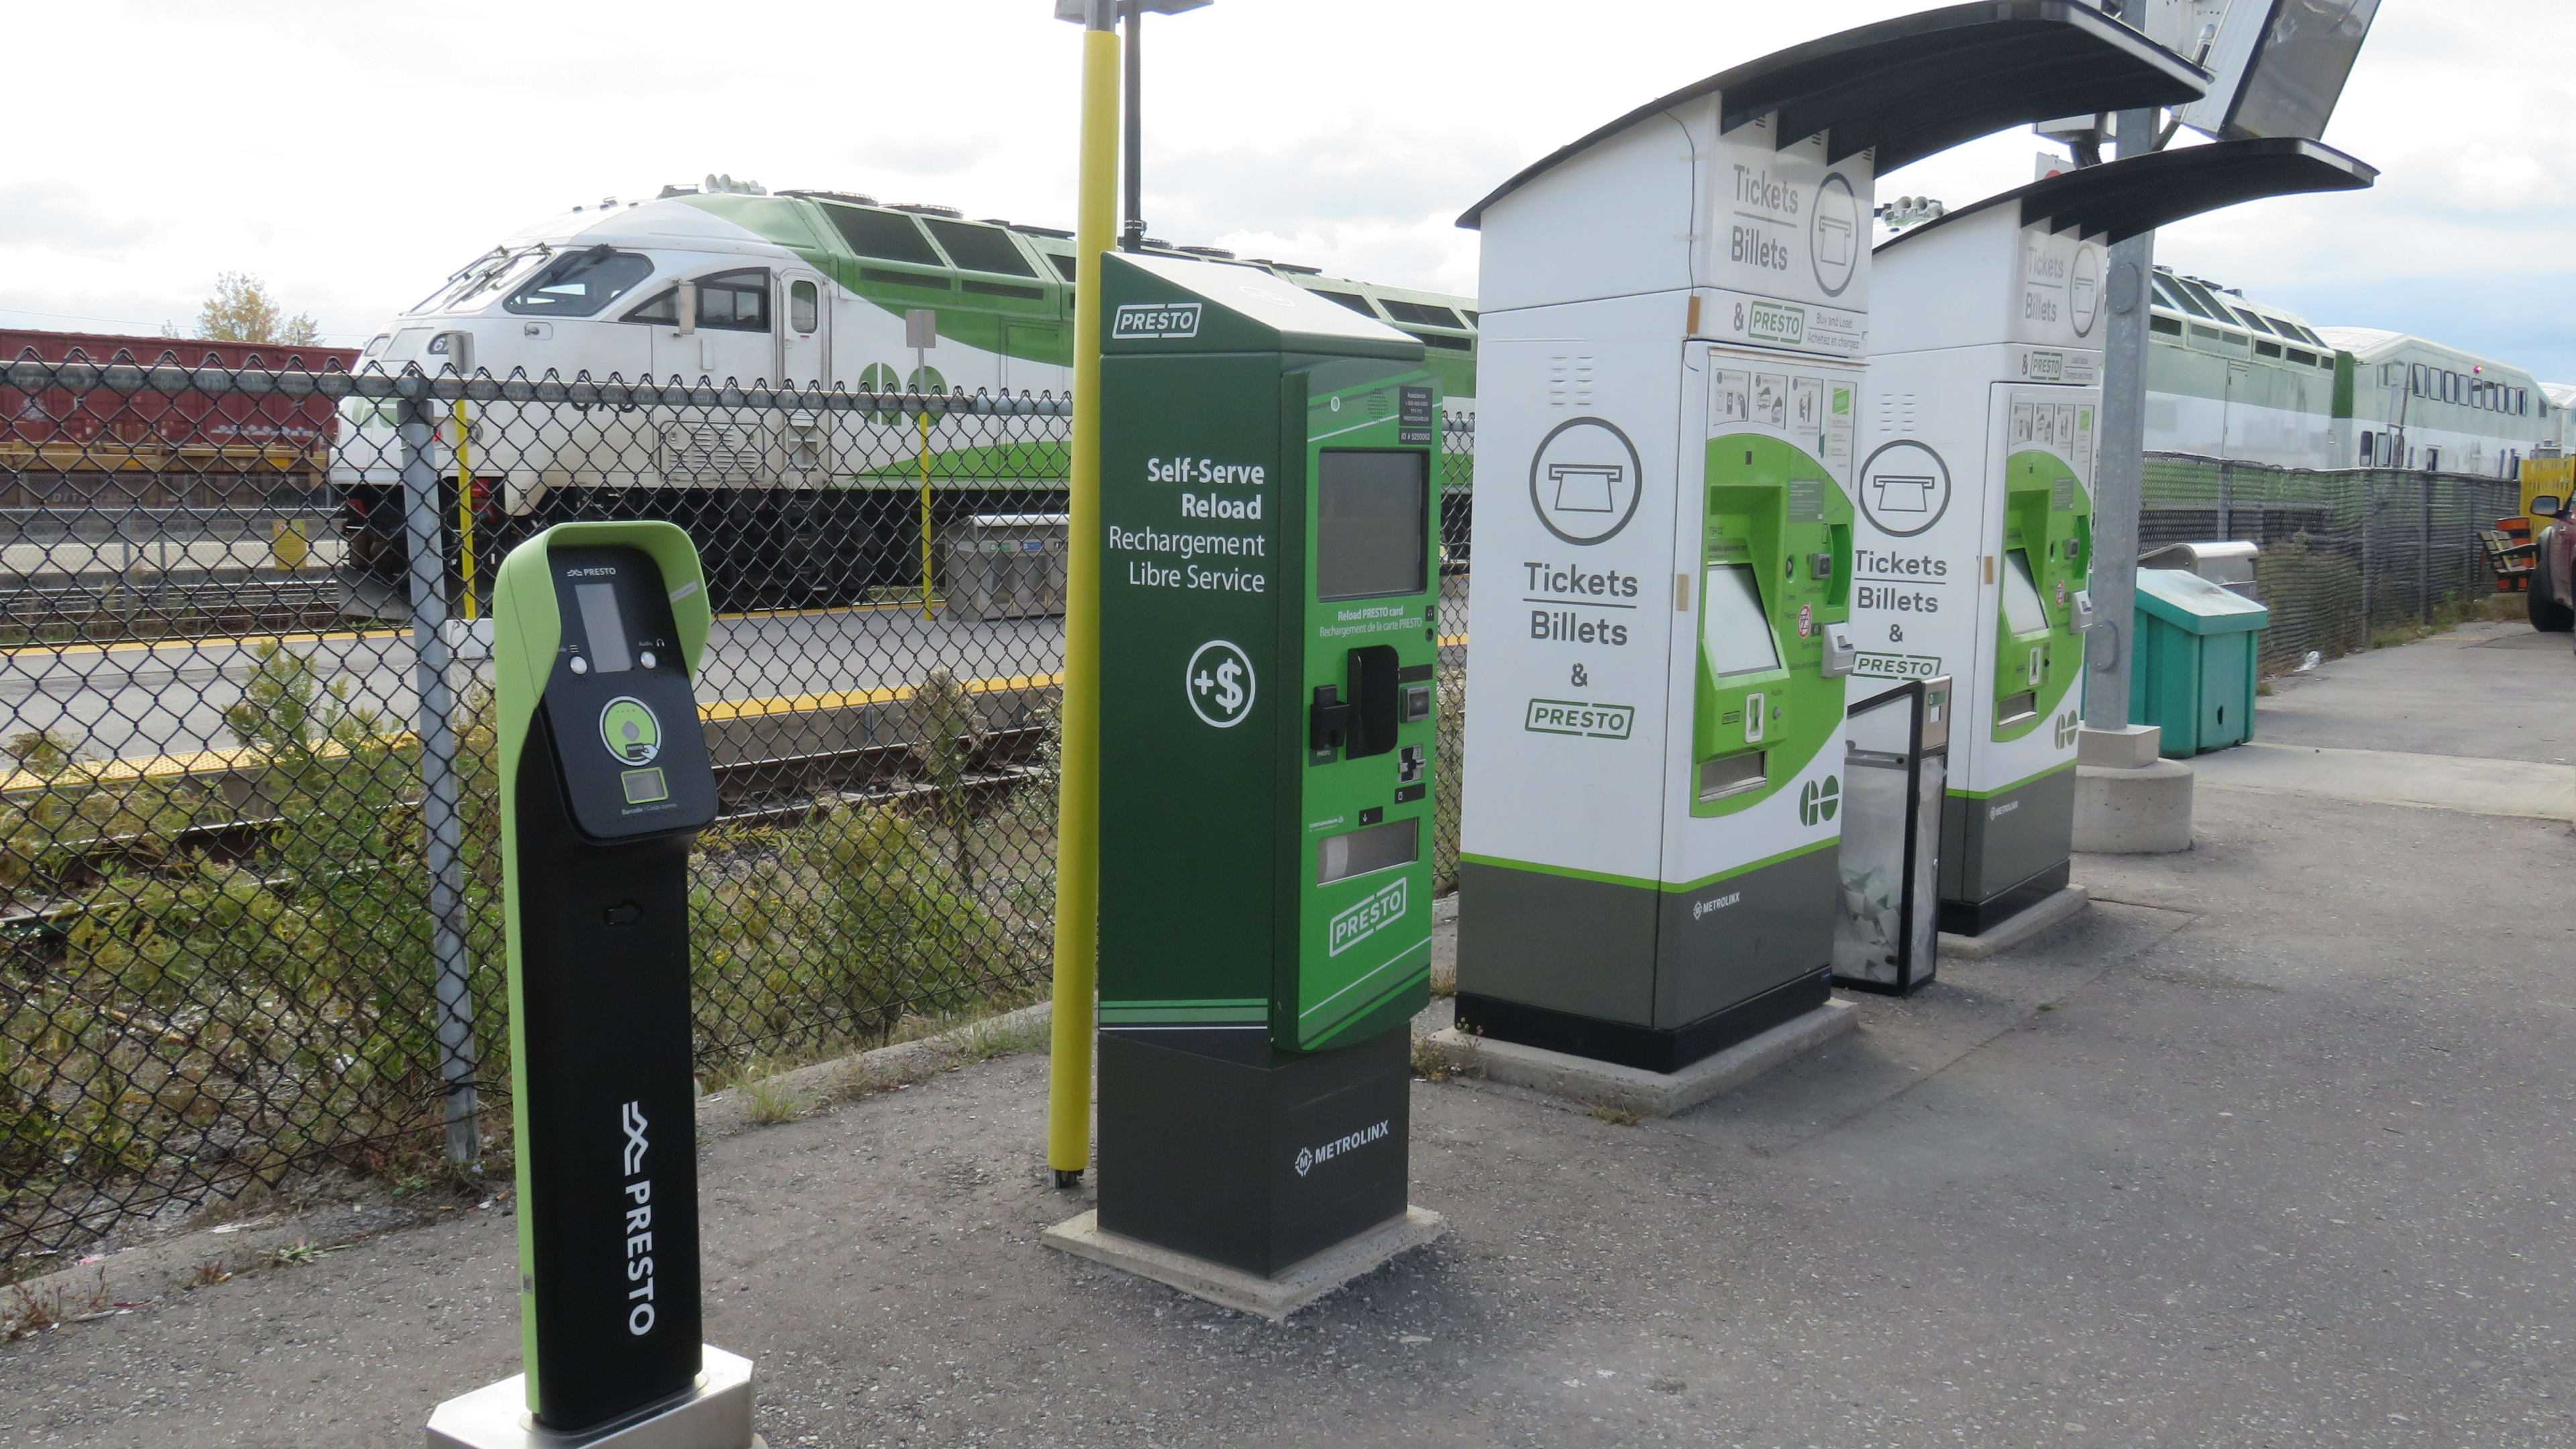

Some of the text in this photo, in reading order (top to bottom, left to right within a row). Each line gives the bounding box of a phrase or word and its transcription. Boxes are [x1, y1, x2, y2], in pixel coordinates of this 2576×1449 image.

[1733, 164, 1798, 214] Tickets
[1731, 225, 1787, 270] Billets
[2028, 246, 2063, 278] Tickets
[1120, 311, 1194, 330] PRESTO
[1734, 303, 1799, 335] & PRESTO
[2025, 292, 2057, 322] Billets
[2033, 356, 2059, 374] PRESTO
[1147, 457, 1265, 485] Self-Serve
[1182, 493, 1261, 520] Reload
[1110, 526, 1265, 559] Rechargement
[584, 568, 616, 576] PRESTO
[1856, 549, 1947, 576] Tickets
[1130, 561, 1265, 593] Libre Service
[1524, 562, 1638, 597] Tickets
[1338, 605, 1403, 621] Reload PRESTO card
[1858, 586, 1938, 613] Billets
[1320, 616, 1422, 638] Rechargement de la carte PRESTO
[1531, 610, 1627, 646] Billets
[1889, 624, 1903, 642] &
[1571, 663, 1588, 687] &
[1858, 658, 1933, 676] PRESTO
[1535, 708, 1624, 731] PRESTO
[1703, 892, 1740, 914] METROLINX
[1336, 890, 1401, 945] PRESTO
[1316, 1119, 1389, 1164] METROLINX
[625, 1179, 656, 1336] PRESTO
